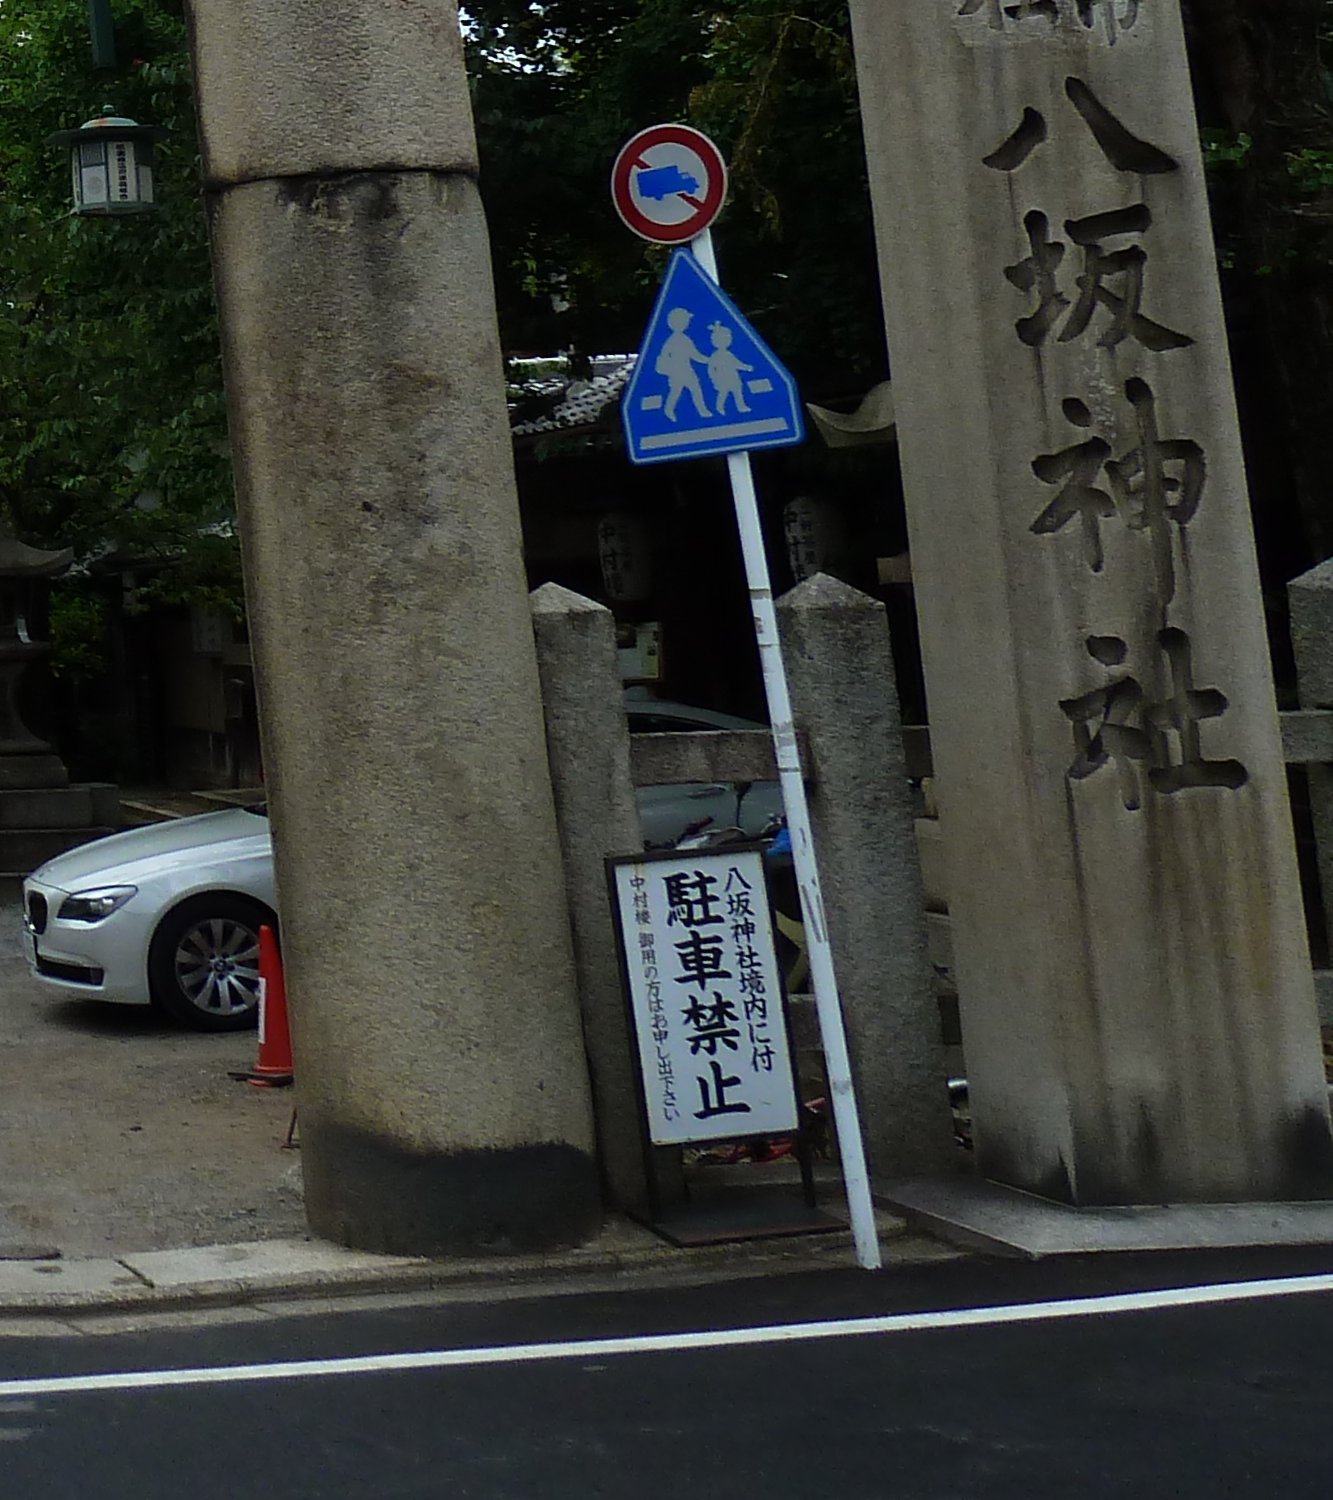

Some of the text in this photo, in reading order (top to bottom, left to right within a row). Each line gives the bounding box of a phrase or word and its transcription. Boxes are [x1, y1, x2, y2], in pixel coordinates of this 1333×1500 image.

[981, 76, 1250, 811] 八坂神社
[661, 870, 751, 1120] 駐車禁止
[722, 867, 775, 1072] 八坂神社境内に付
